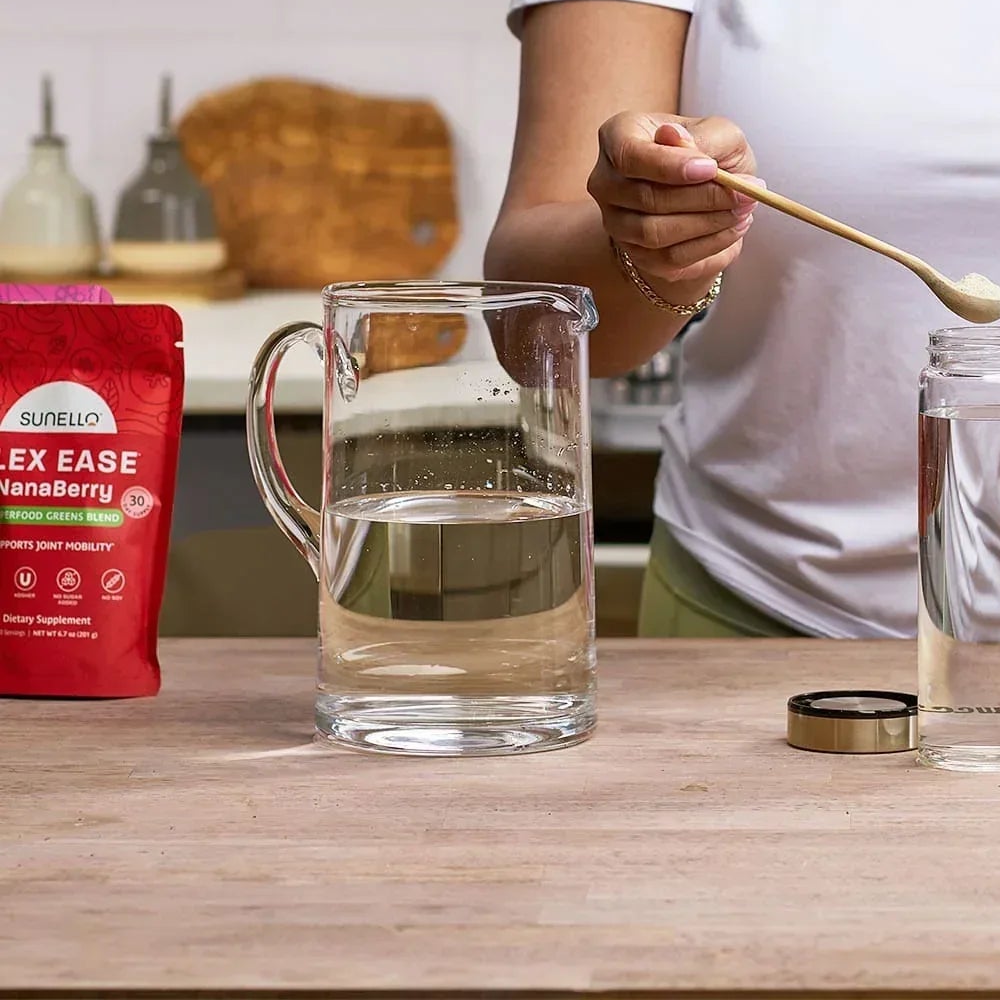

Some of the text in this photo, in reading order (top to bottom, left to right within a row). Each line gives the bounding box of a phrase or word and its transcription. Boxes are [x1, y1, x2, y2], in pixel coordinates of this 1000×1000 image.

[20, 411, 100, 427] SUNELLO
[57, 449, 139, 474] EASE
[0, 478, 113, 504] NanaBerry
[129, 495, 145, 507] 30
[46, 511, 84, 521] GREENS
[86, 512, 120, 523] BLEND
[36, 541, 63, 552] JOINT
[3, 614, 92, 626] Dietary Supplement
